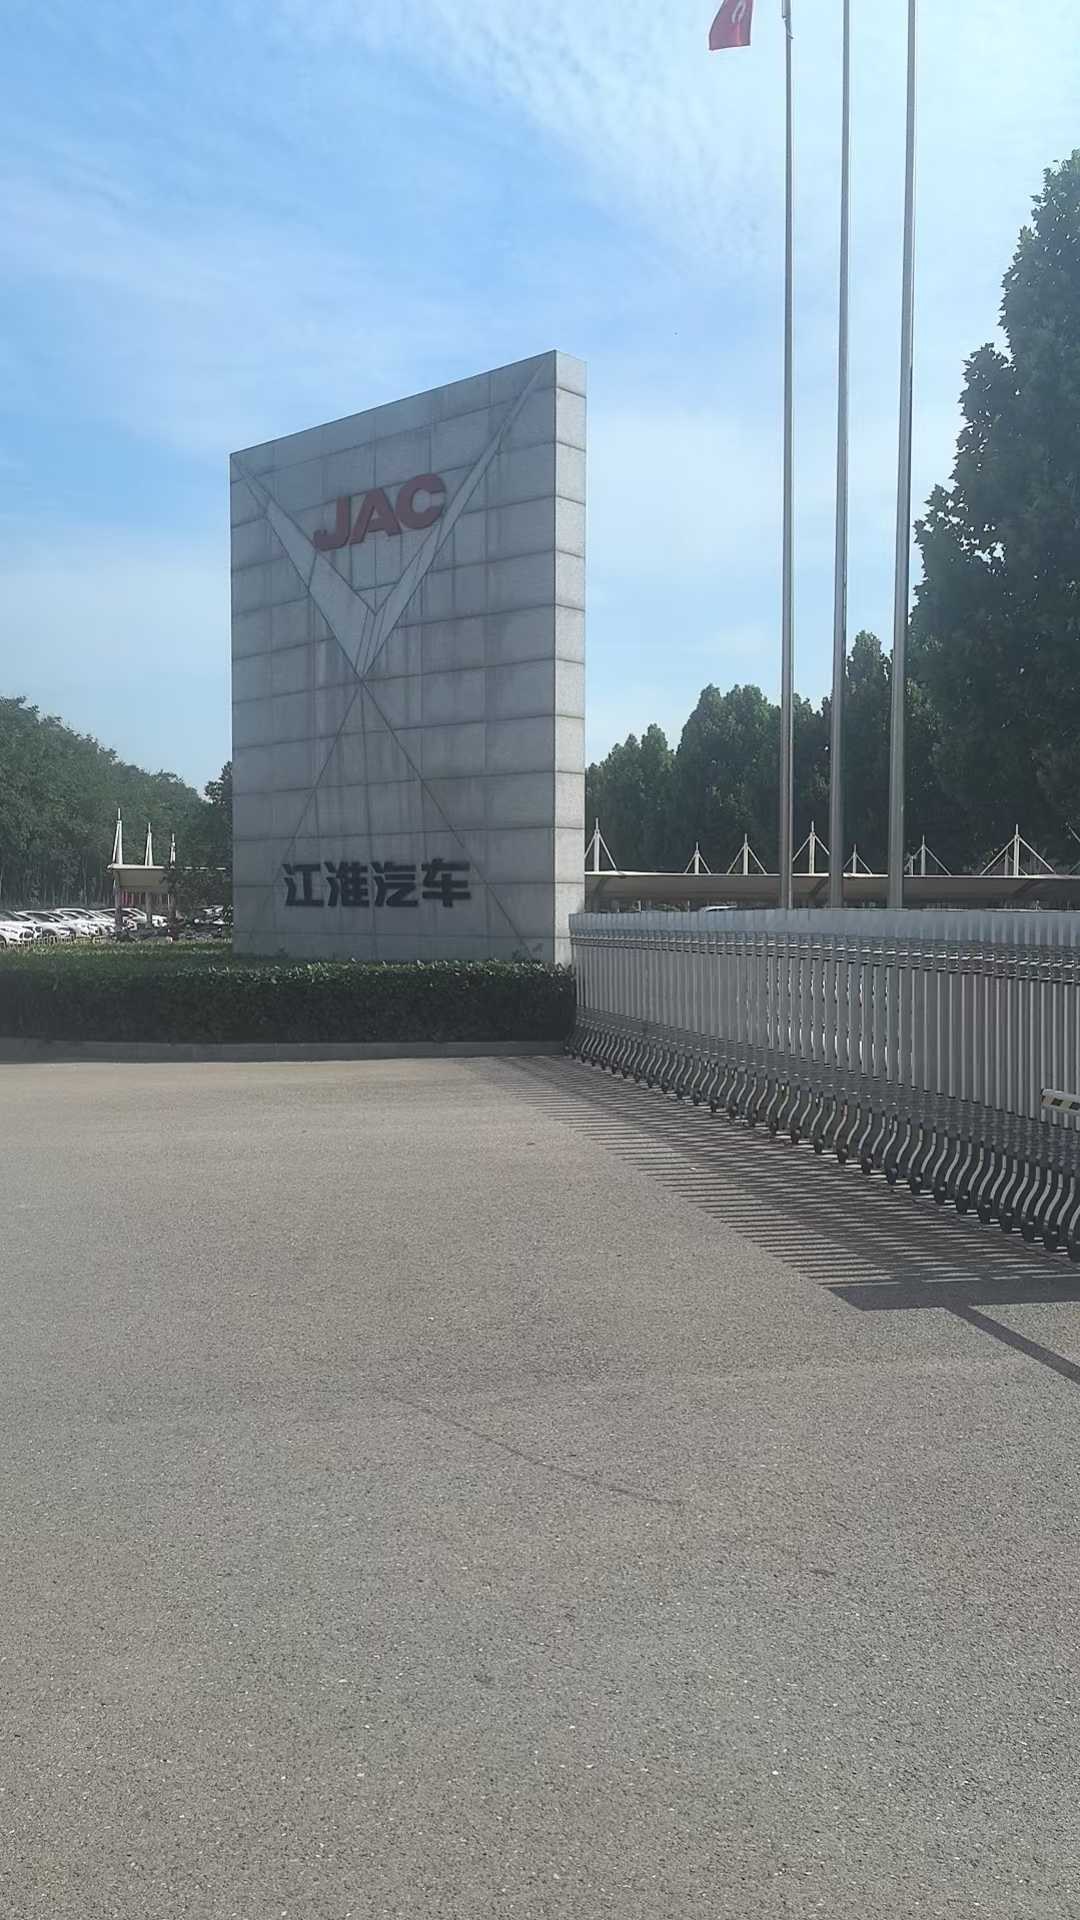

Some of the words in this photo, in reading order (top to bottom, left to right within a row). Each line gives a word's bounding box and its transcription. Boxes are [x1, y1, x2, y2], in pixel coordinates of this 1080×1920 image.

[312, 473, 446, 551] JAC
[282, 858, 472, 908] 江淮汽车
